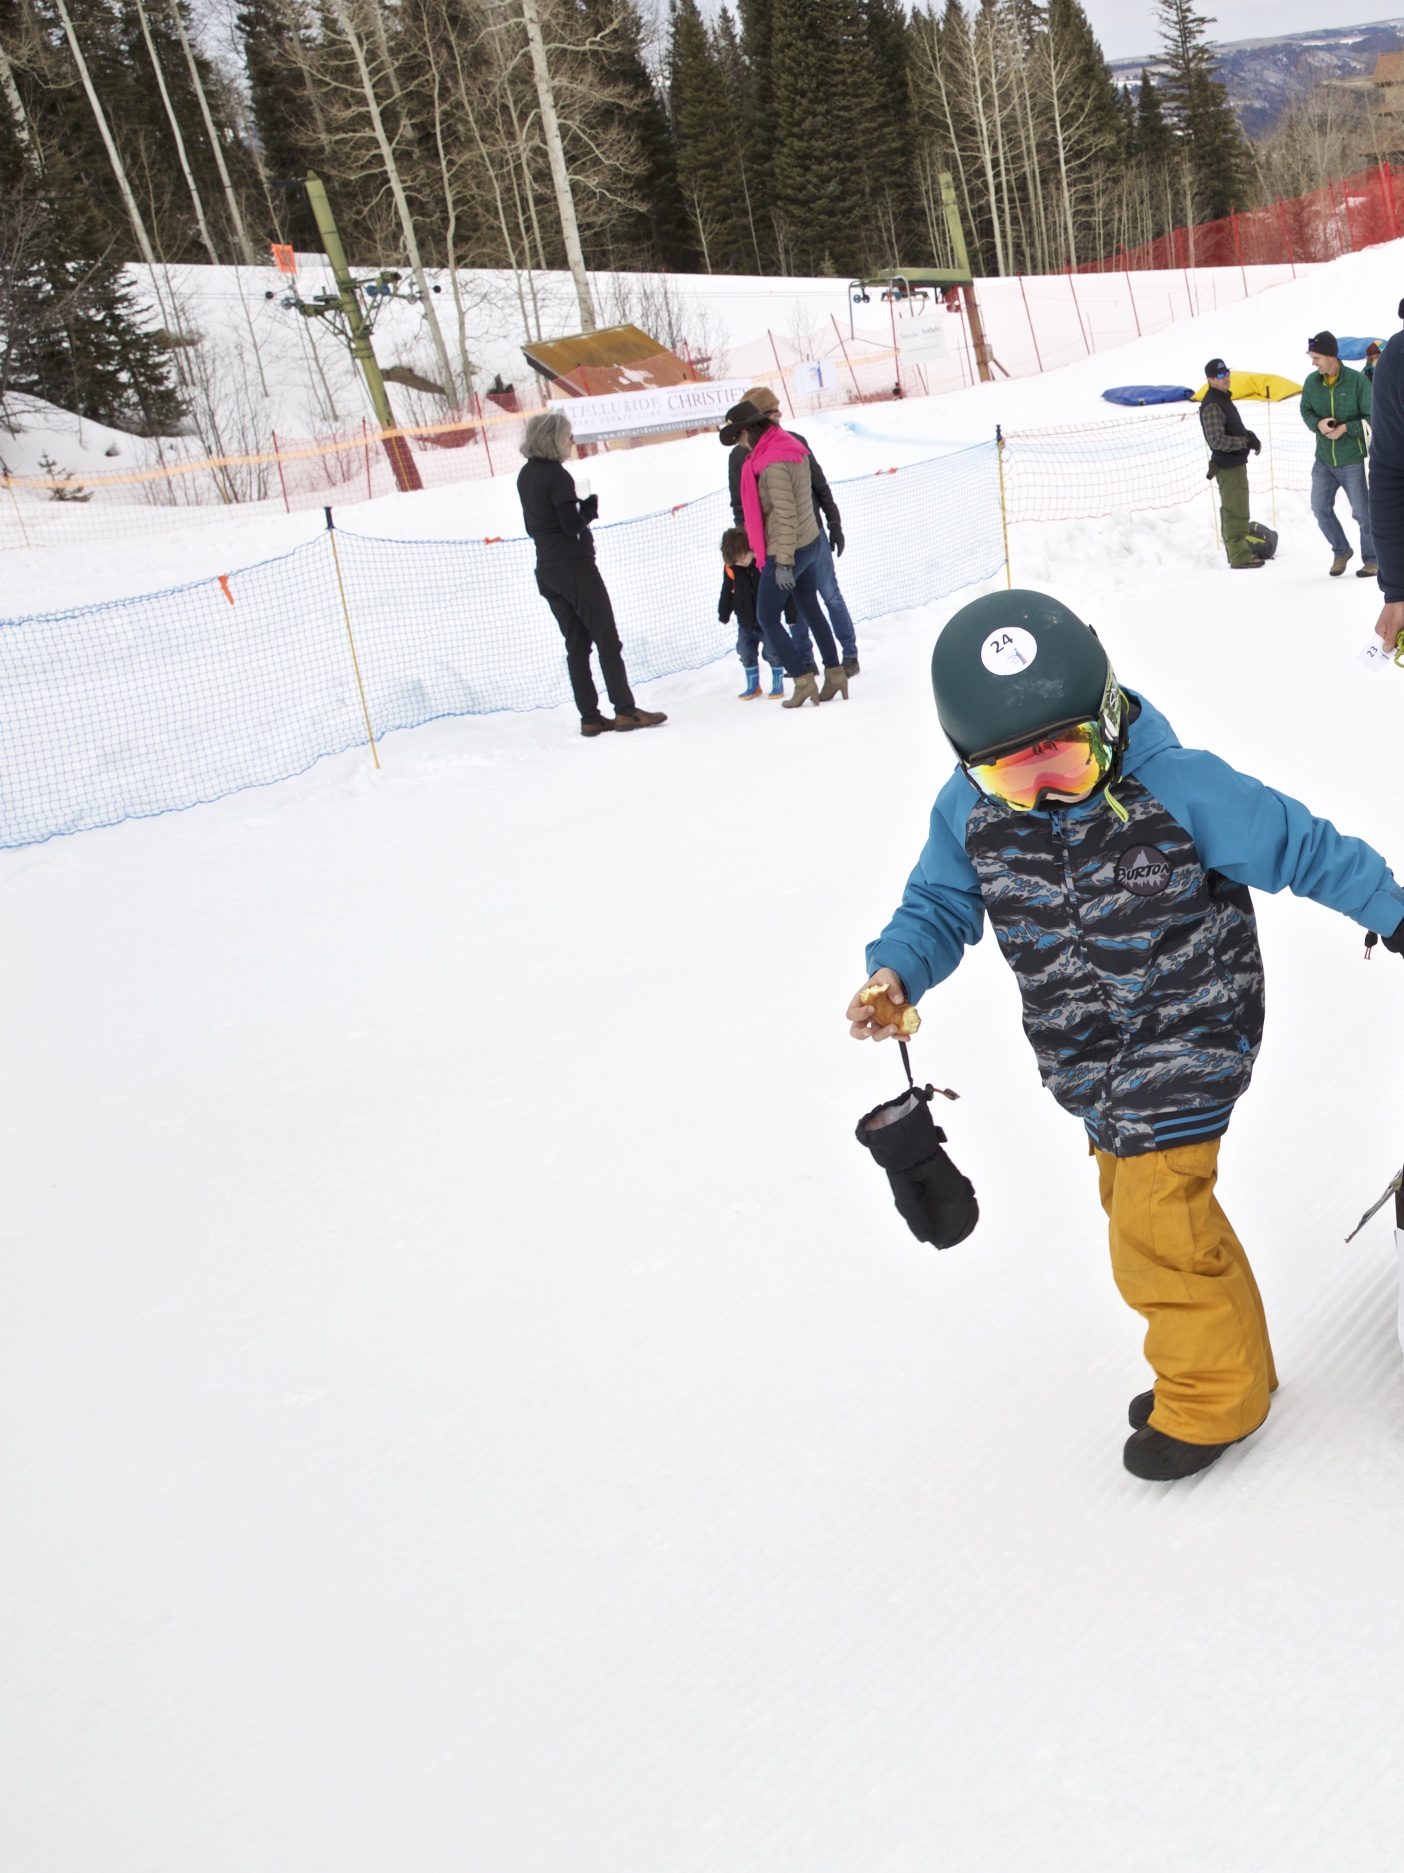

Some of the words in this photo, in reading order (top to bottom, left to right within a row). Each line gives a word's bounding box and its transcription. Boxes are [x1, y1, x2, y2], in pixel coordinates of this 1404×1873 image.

[569, 396, 662, 419] TELLURIDE
[671, 408, 716, 419] INTERNATIONAL
[573, 418, 595, 426] REAL
[601, 415, 632, 424] ESTATE
[637, 410, 661, 419] CORP
[597, 418, 722, 439] www.telluriderealestatecorp.com
[990, 633, 1013, 654] 24
[1366, 645, 1378, 658] 23
[1117, 864, 1169, 881] BURTON
